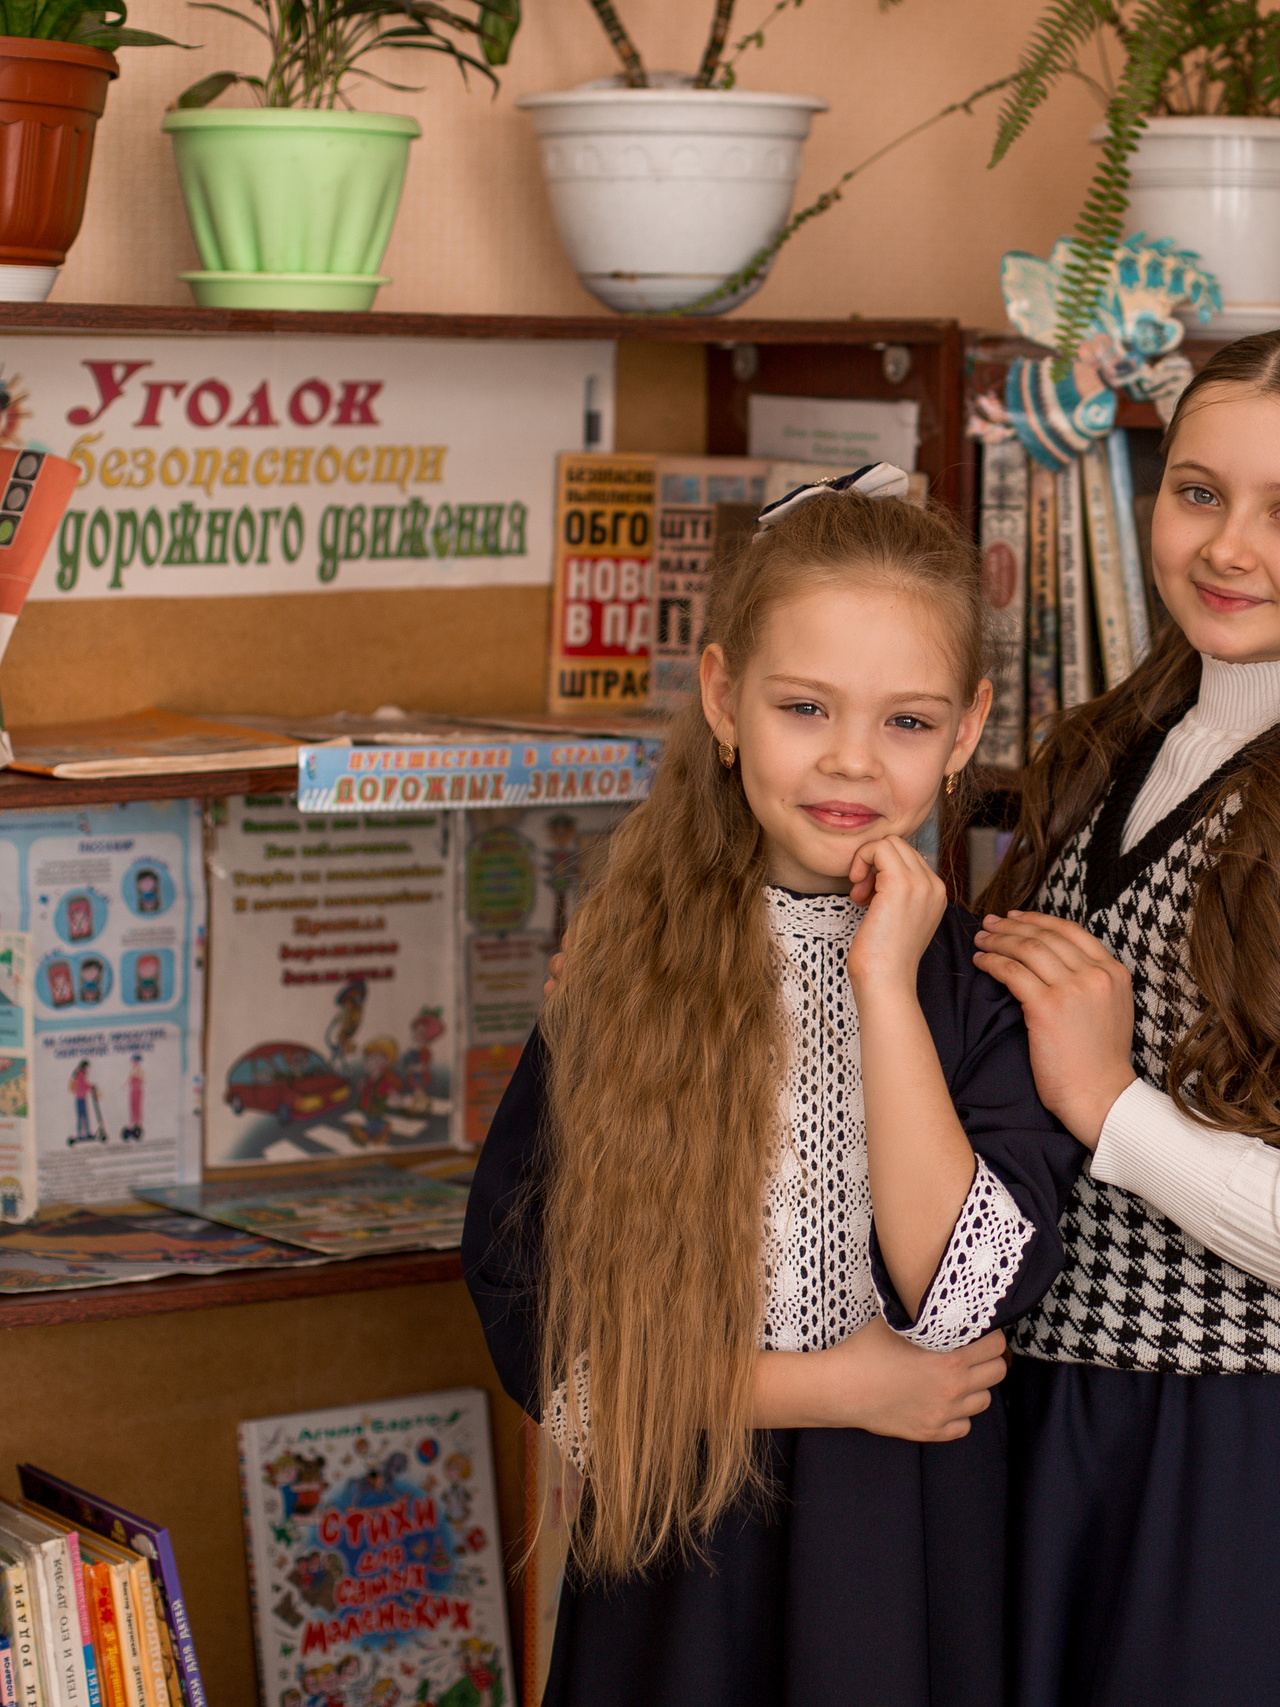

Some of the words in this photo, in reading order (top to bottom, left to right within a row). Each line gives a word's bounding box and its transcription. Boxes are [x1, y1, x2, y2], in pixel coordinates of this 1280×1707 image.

[67, 360, 387, 427] Уголок
[70, 434, 449, 496] безопасности
[56, 502, 304, 591] дорожного
[318, 497, 528, 584] движения
[564, 508, 649, 546] ОБГО
[565, 604, 591, 646] В
[348, 747, 511, 770] ПУТЕШЕСТВИЕ
[523, 747, 538, 767] В
[550, 744, 631, 766] СТРАНУ
[335, 772, 507, 804] ДОРОЖНЫХ
[528, 768, 634, 799] ЗНАКОВ
[300, 1423, 364, 1443] Агния
[371, 1413, 440, 1434] Барто
[53, 1557, 69, 1610] ДРУЗЬЯ
[14, 1583, 34, 1668] РОДАРИ
[59, 1615, 72, 1643] ЕГО
[171, 1598, 191, 1640] ДЕТЕЙ
[63, 1648, 73, 1659] И
[182, 1644, 199, 1673] ДЛЯ
[65, 1664, 78, 1700] ГЕНА
